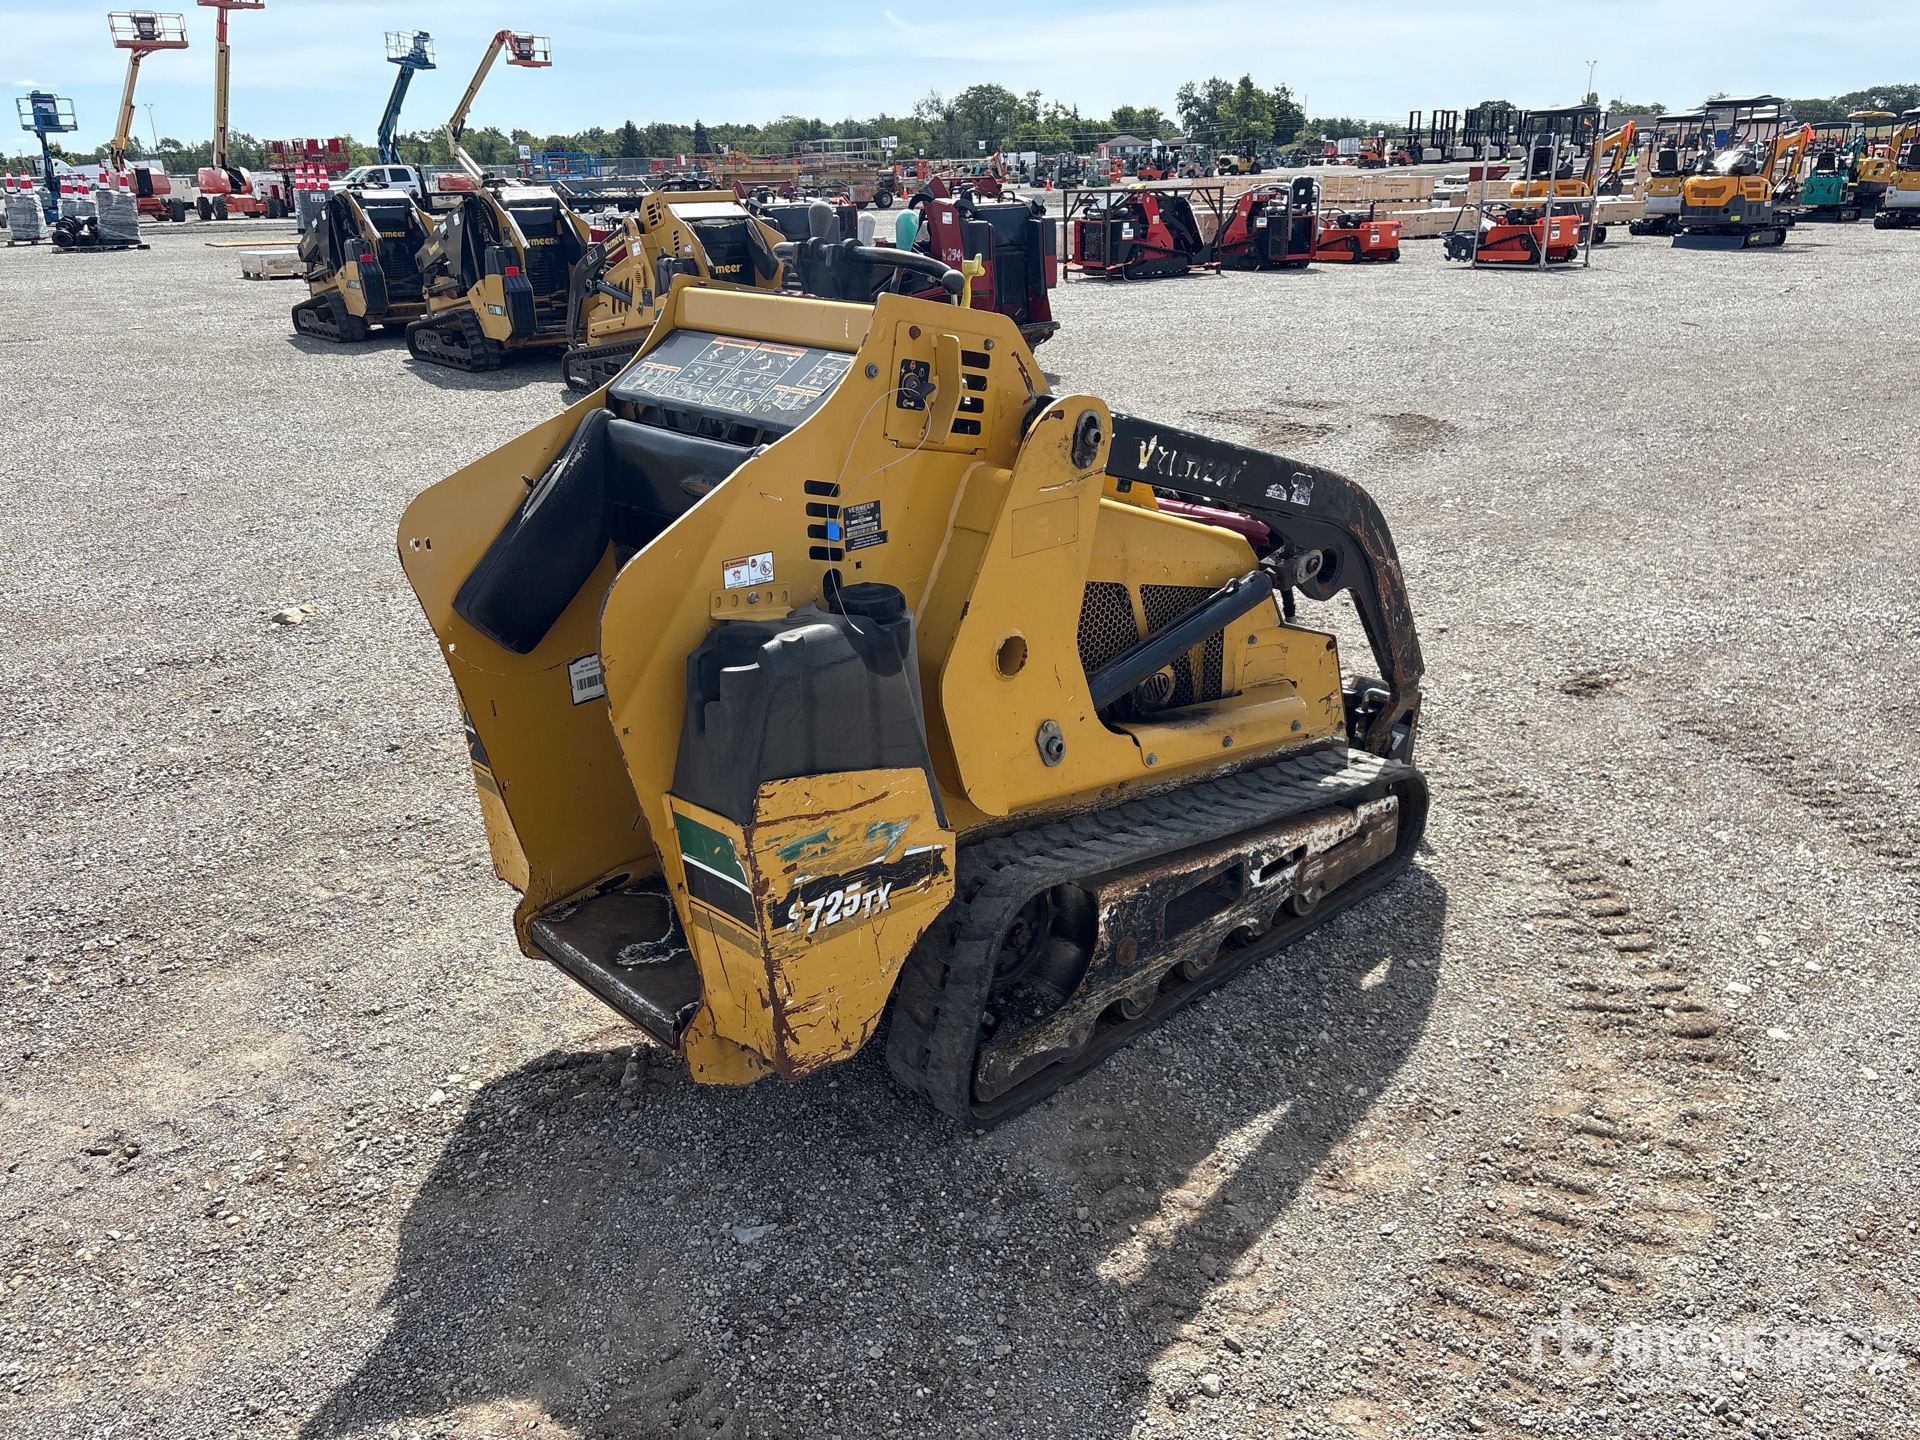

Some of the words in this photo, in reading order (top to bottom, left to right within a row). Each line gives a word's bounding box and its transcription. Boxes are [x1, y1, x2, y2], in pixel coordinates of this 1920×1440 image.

[528, 237, 554, 246] rmeer
[715, 264, 741, 274] meer
[847, 503, 875, 513] VERMEER
[786, 881, 893, 934] S725TX
